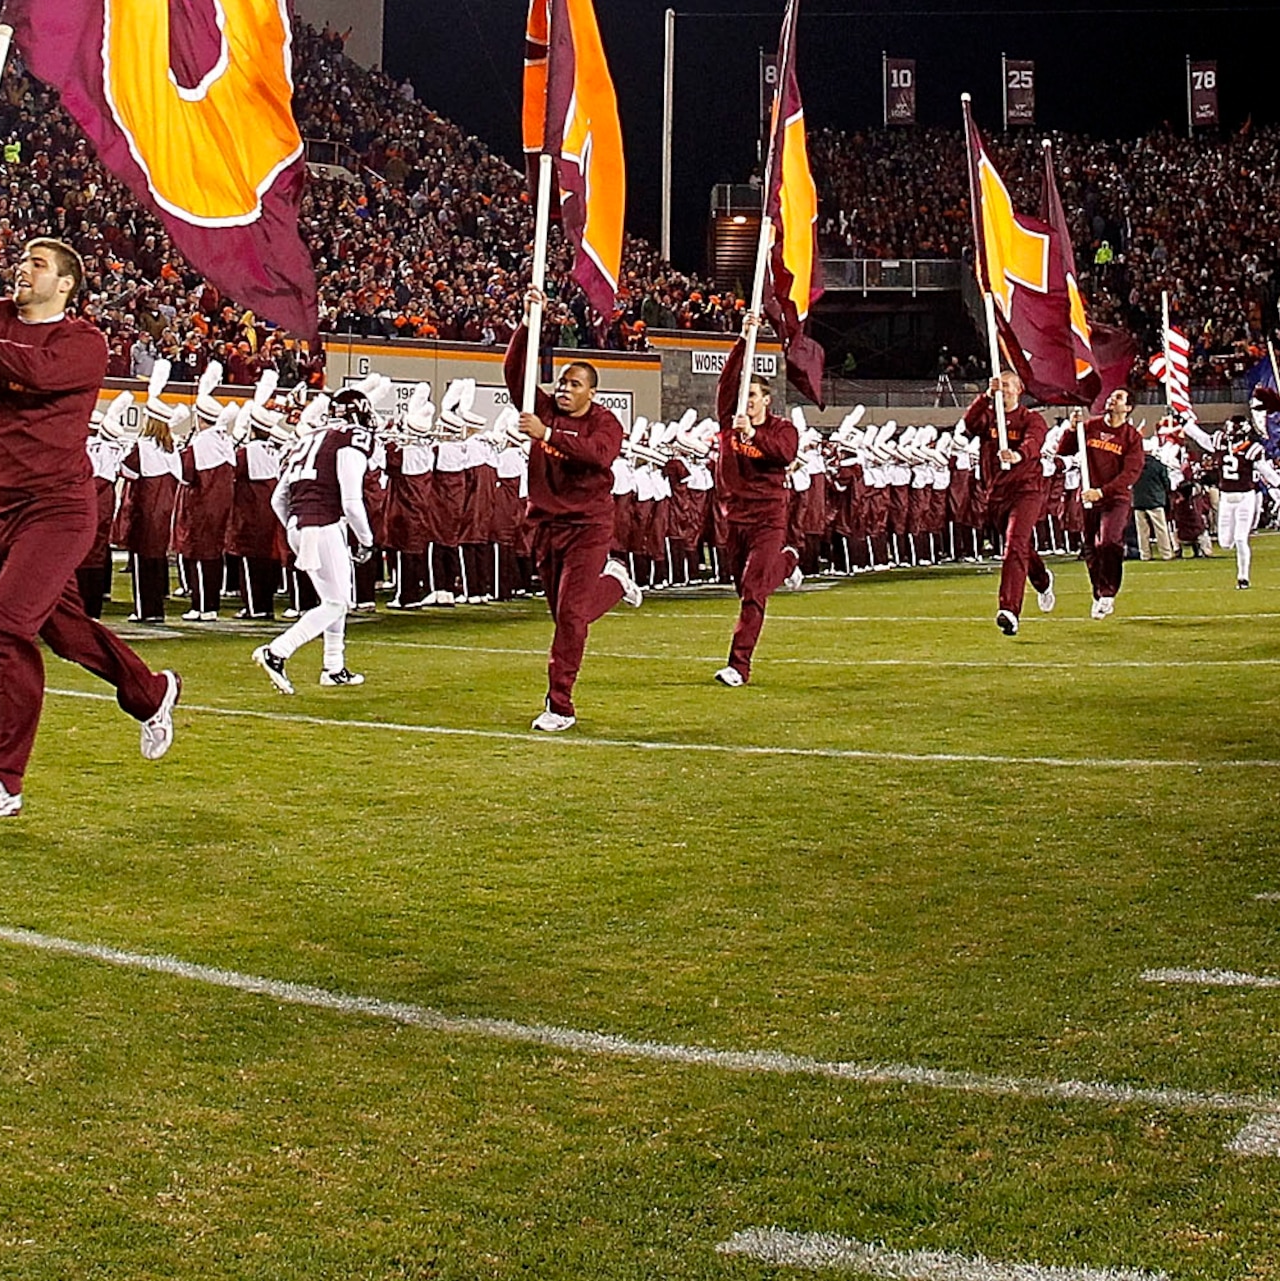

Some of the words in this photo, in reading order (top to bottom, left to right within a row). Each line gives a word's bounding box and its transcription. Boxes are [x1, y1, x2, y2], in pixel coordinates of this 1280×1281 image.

[890, 69, 912, 88] 10
[1008, 70, 1034, 89] 25
[1192, 71, 1216, 90] 78
[359, 358, 369, 374] G
[695, 354, 726, 371] WORS
[752, 357, 774, 373] IELD
[494, 392, 513, 404] 20
[600, 398, 628, 409] 2003
[351, 428, 372, 452] 21
[1087, 438, 1123, 455] FOOTBALL
[288, 431, 327, 482] 21
[1222, 454, 1240, 480] 2
